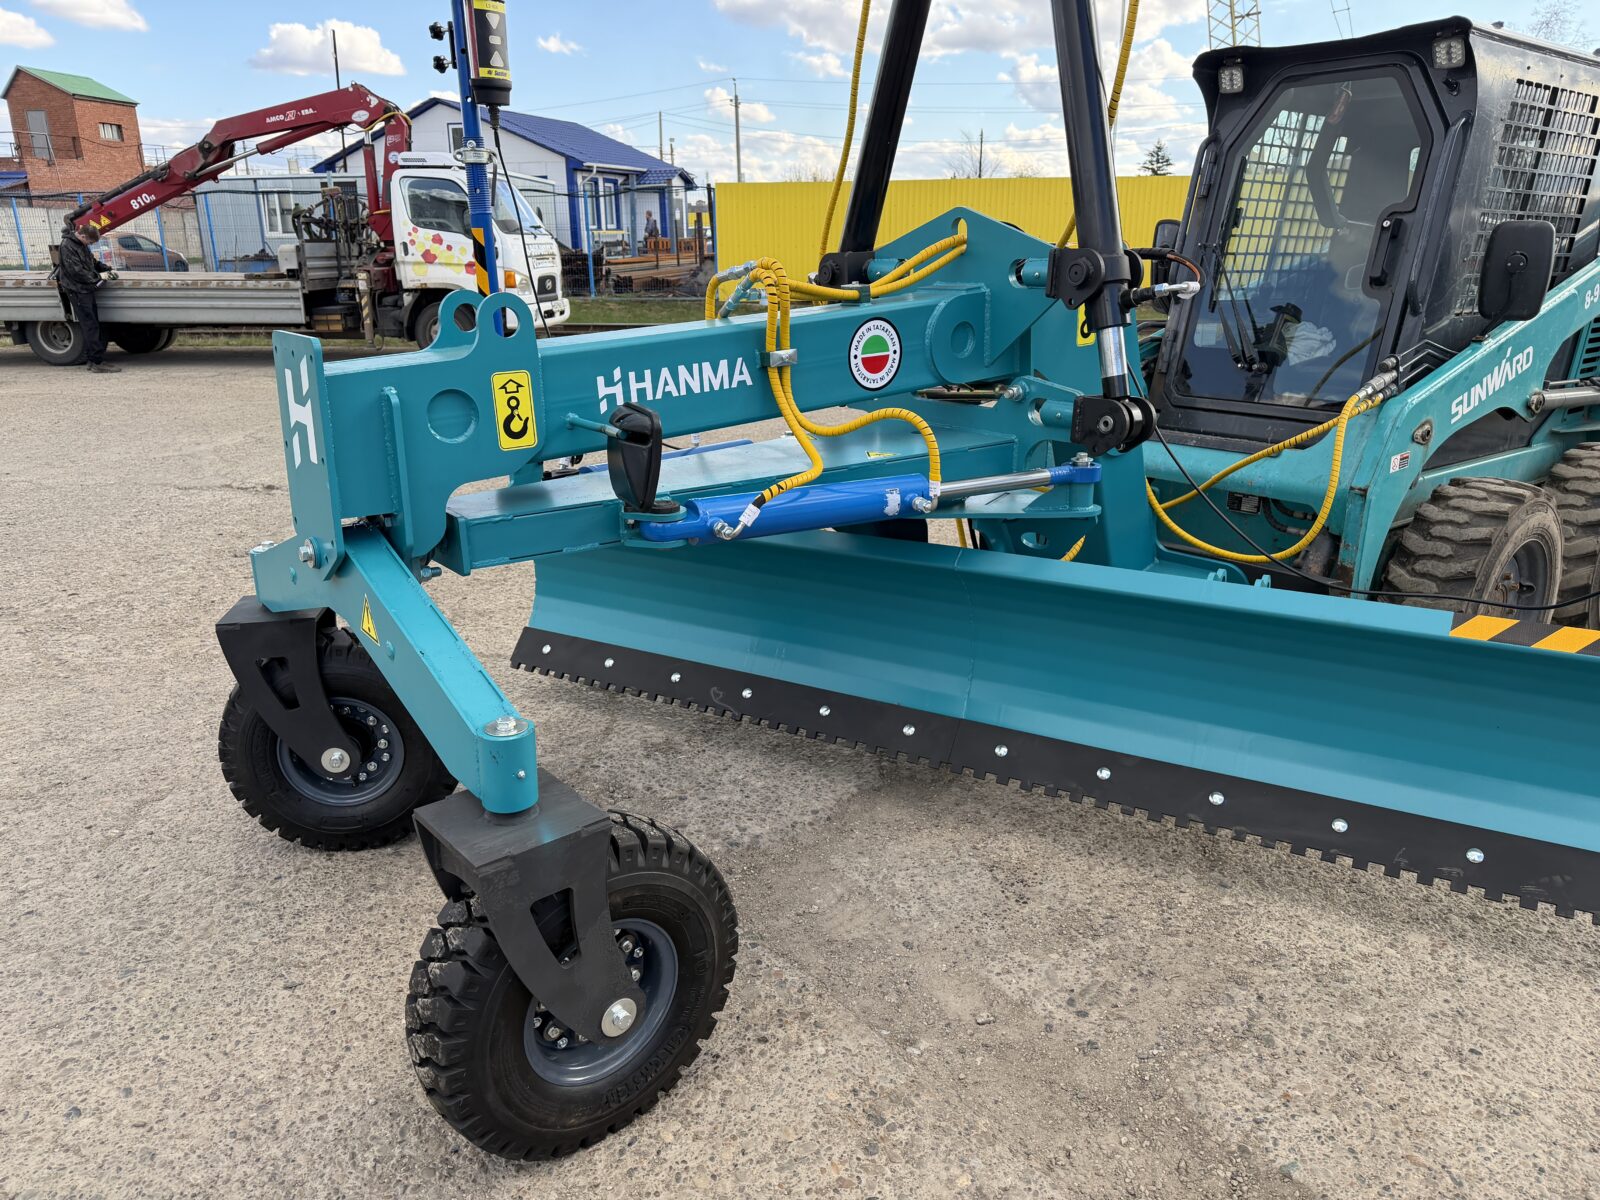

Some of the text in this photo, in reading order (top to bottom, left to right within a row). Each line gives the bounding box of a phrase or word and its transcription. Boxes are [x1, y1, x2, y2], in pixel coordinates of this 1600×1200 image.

[854, 331, 866, 351] MADE
[873, 324, 896, 347] TATARSTAN
[628, 356, 753, 403] HANMA
[854, 362, 879, 384] TATARSTAN
[885, 357, 897, 376] MADE
[1450, 346, 1534, 425] SUNWARD
